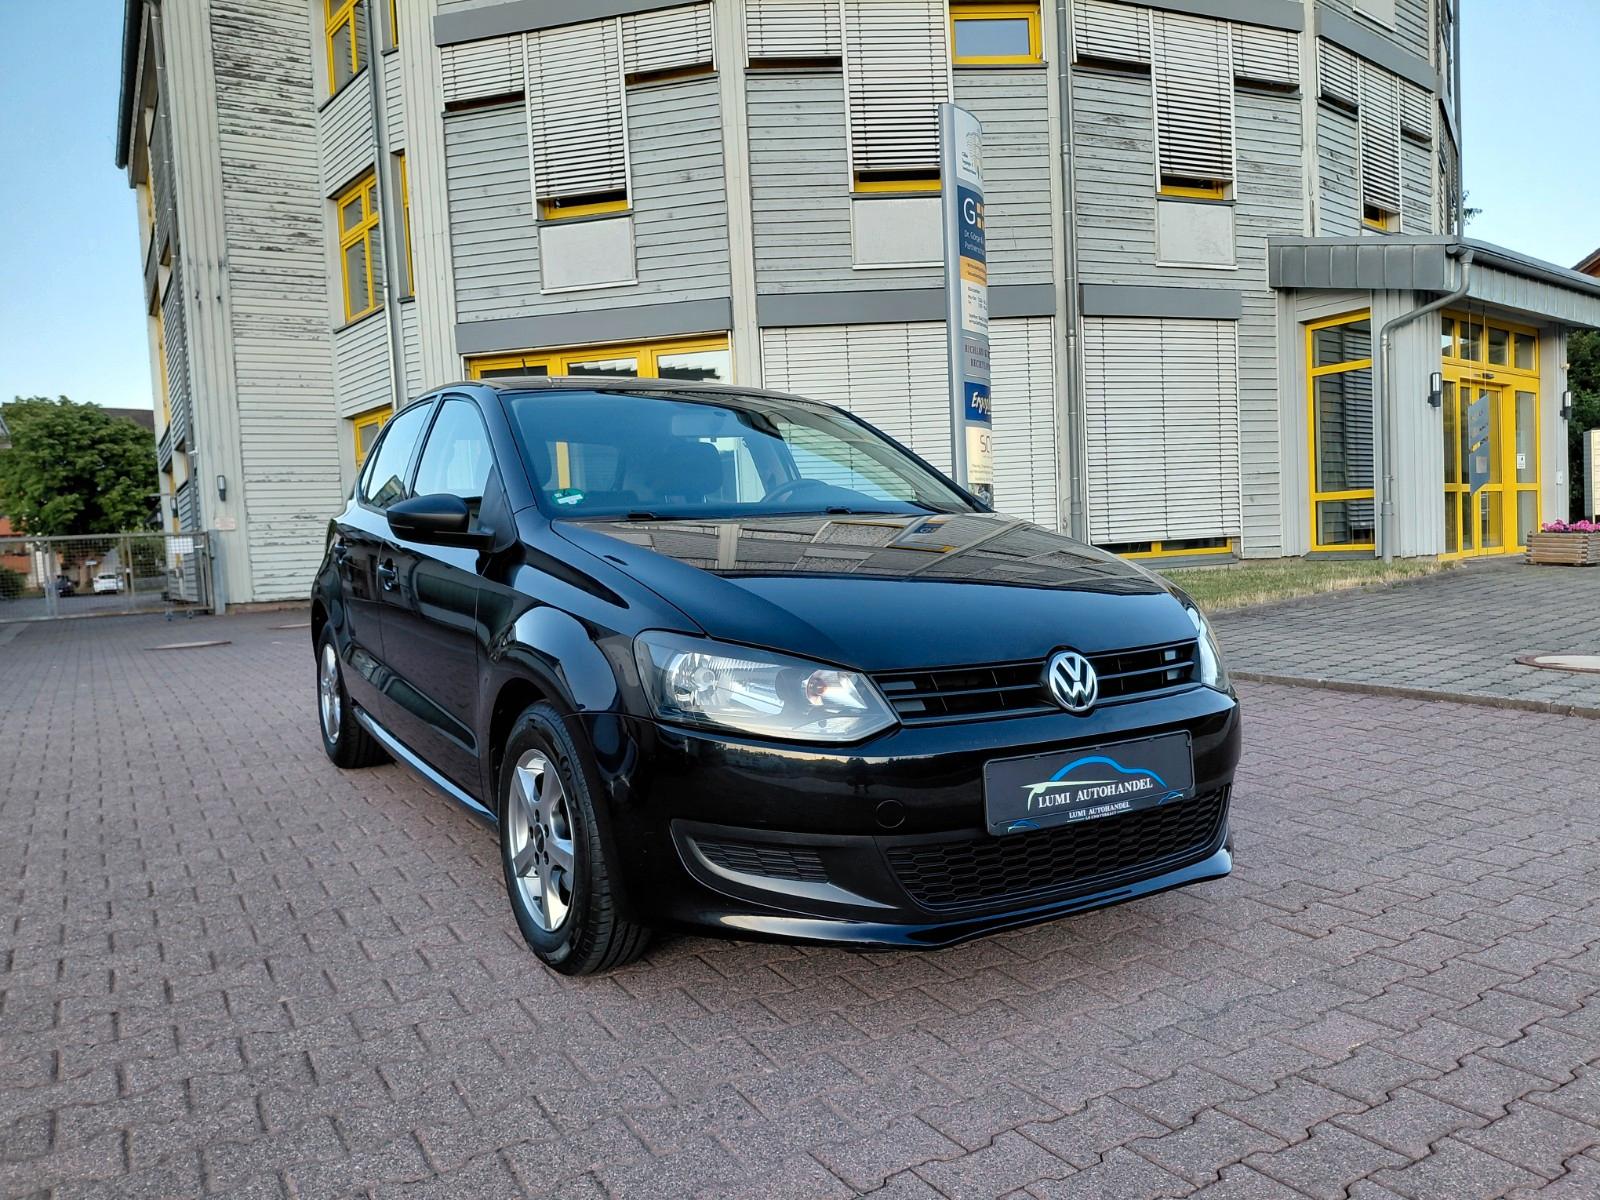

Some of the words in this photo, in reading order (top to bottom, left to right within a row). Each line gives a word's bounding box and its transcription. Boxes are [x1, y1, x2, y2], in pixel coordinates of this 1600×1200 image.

[1049, 652, 1098, 712] VW
[1038, 794, 1071, 809] LUMI
[1075, 777, 1154, 803] AUTOHANDEL
[1068, 809, 1087, 819] LUMI
[1088, 801, 1131, 816] AUTOHANDEL
